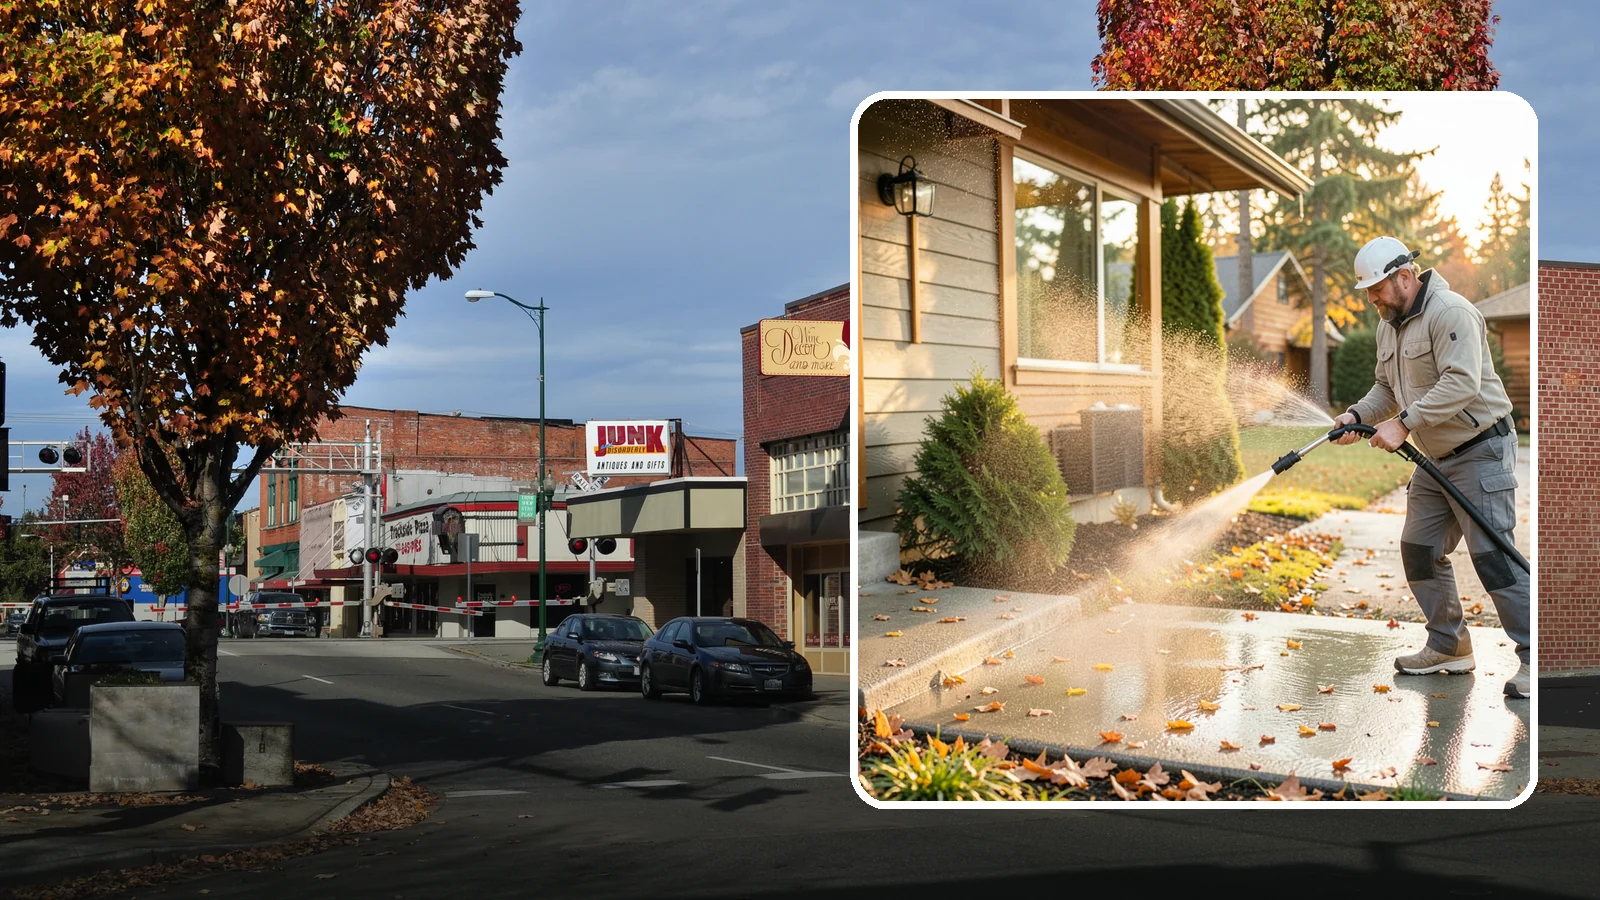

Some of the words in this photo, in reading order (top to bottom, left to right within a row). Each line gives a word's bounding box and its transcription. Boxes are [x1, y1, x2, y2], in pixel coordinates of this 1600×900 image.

[595, 425, 665, 457] JUNK
[607, 446, 645, 454] DISORDERLY
[597, 461, 628, 470] ANTIQUES
[631, 461, 644, 470] AND
[647, 460, 665, 469] GIFTS
[352, 498, 365, 511] CRO
[414, 519, 429, 535] Pizza
